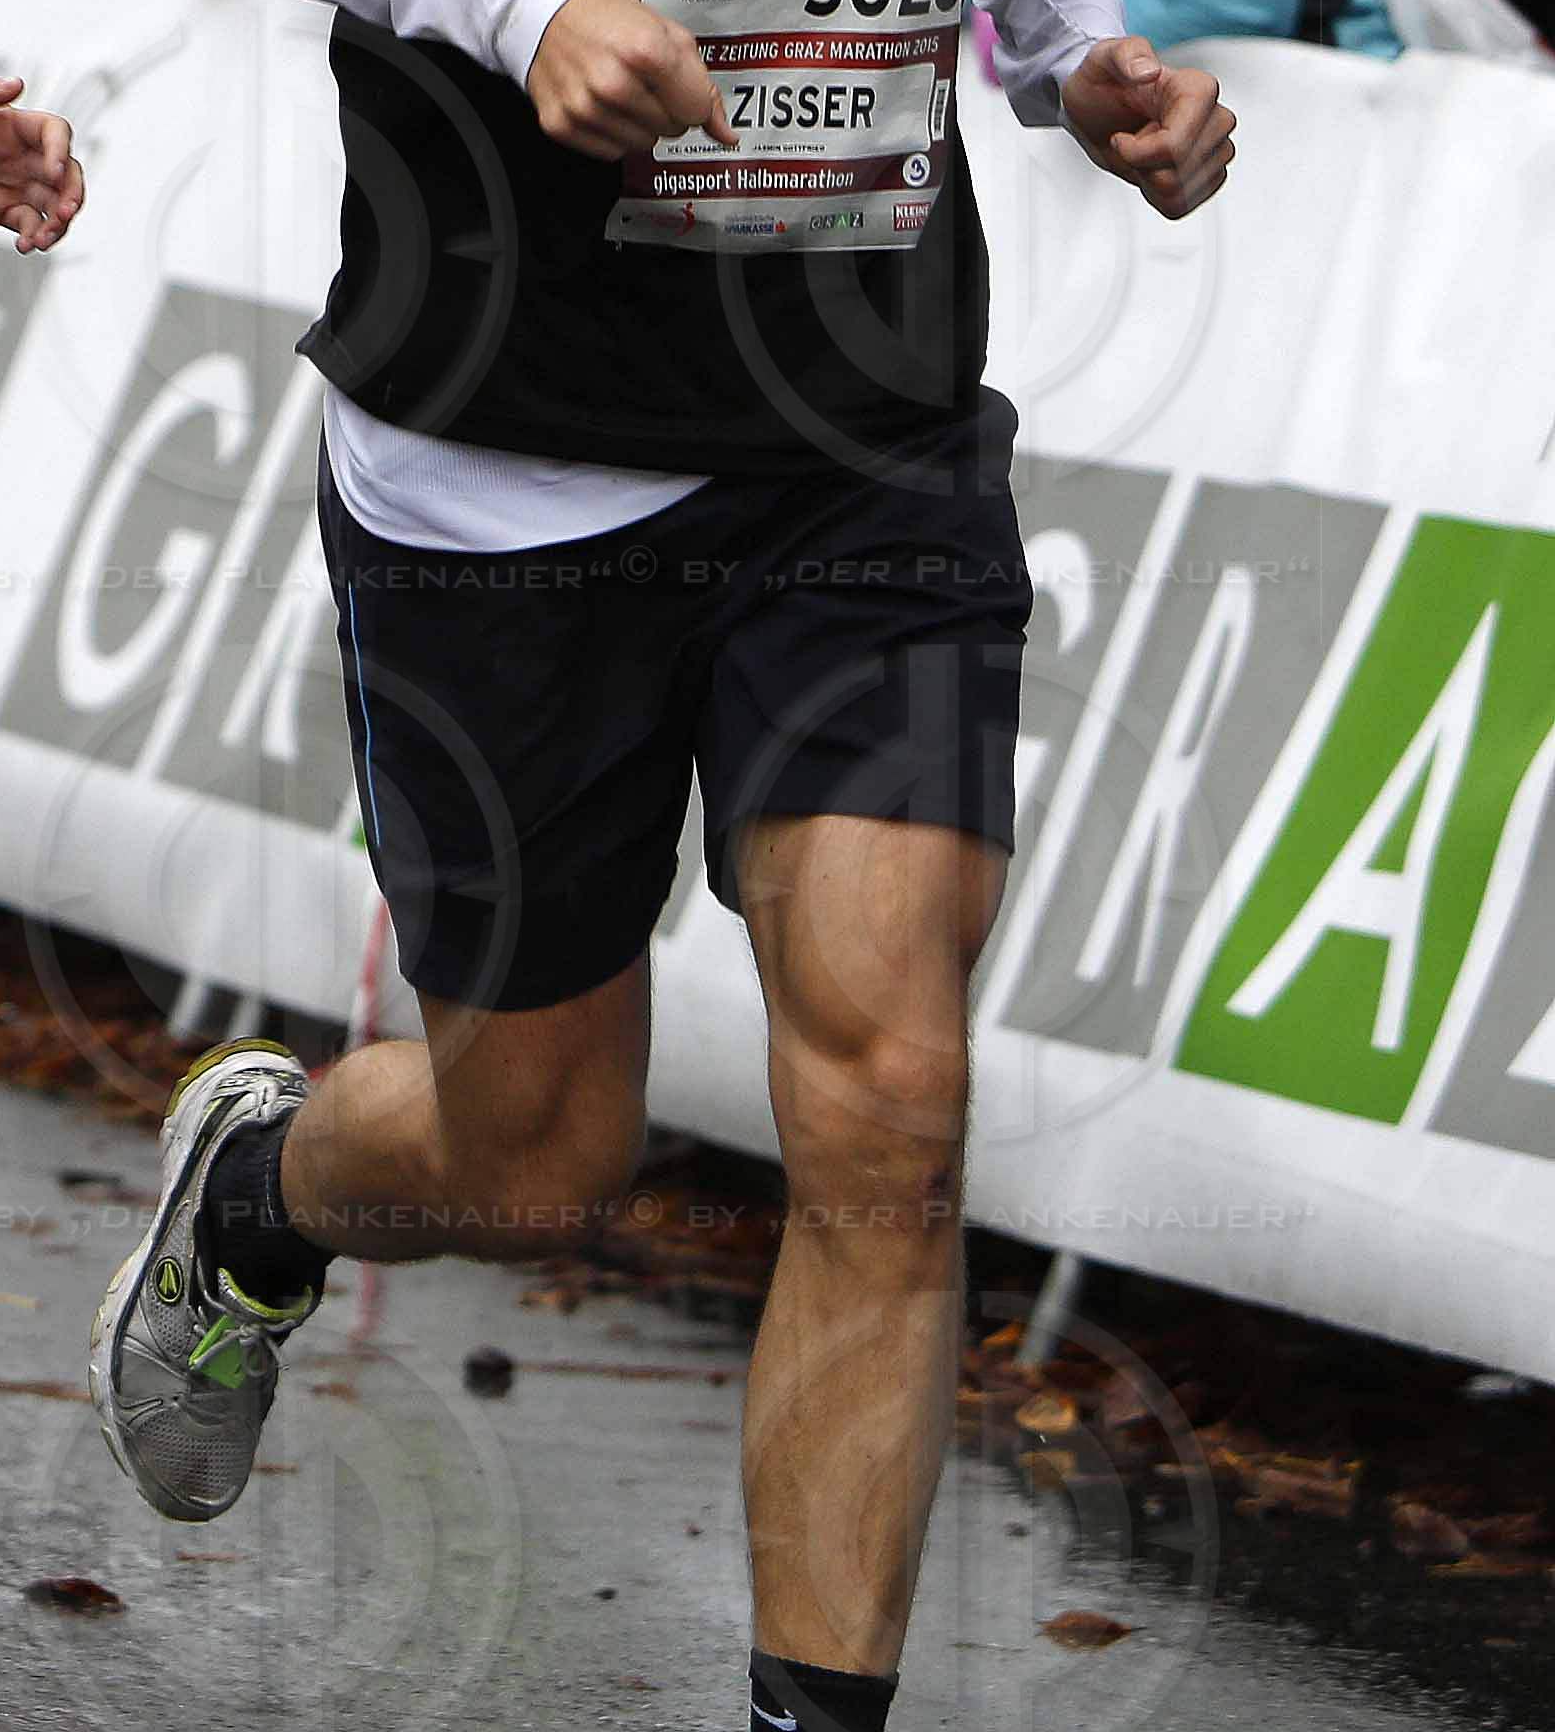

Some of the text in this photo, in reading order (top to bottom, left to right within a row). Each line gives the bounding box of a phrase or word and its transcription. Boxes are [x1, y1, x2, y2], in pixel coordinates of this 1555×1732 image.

[720, 40, 779, 61] ZEITUNG
[784, 42, 824, 60] GRAZ
[829, 40, 910, 60] MARATHON
[913, 36, 939, 56] 2015
[730, 85, 876, 129] ZISSER
[653, 169, 855, 196] gigasport Halbmarathon
